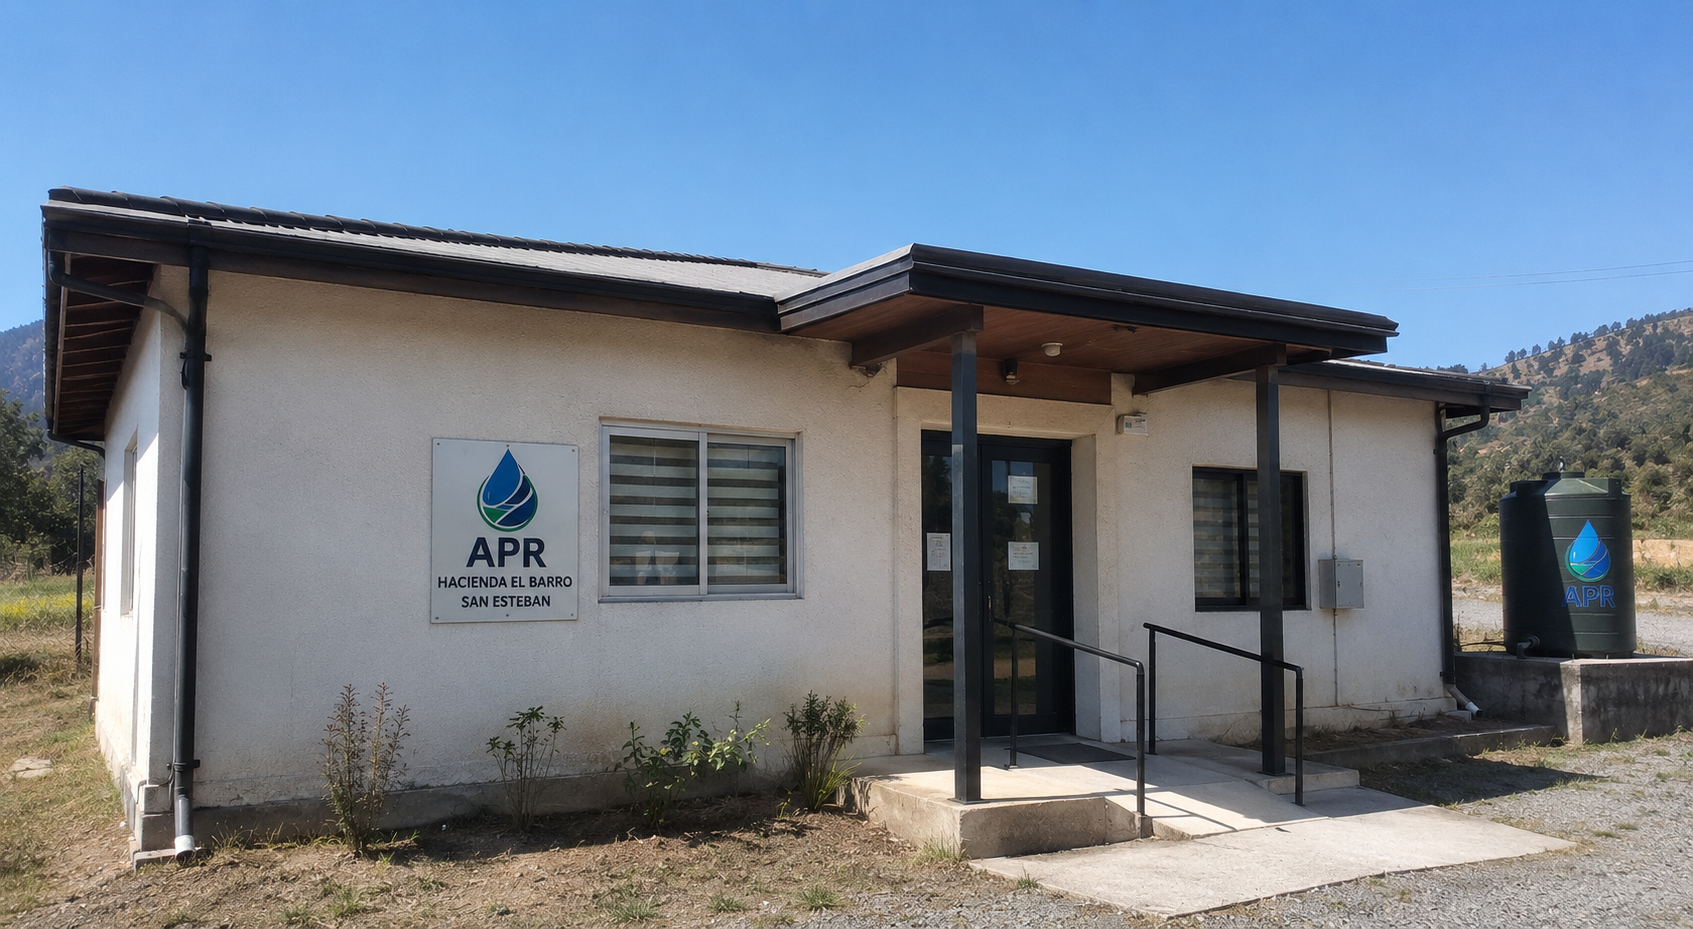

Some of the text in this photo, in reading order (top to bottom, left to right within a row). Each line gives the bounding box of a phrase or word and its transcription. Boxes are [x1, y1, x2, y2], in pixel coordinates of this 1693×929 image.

[466, 536, 547, 568] APR
[437, 575, 573, 588] HACIENDA EL BARRO
[461, 595, 551, 608] SAN ESTEBAN
[1561, 585, 1616, 608] APR
